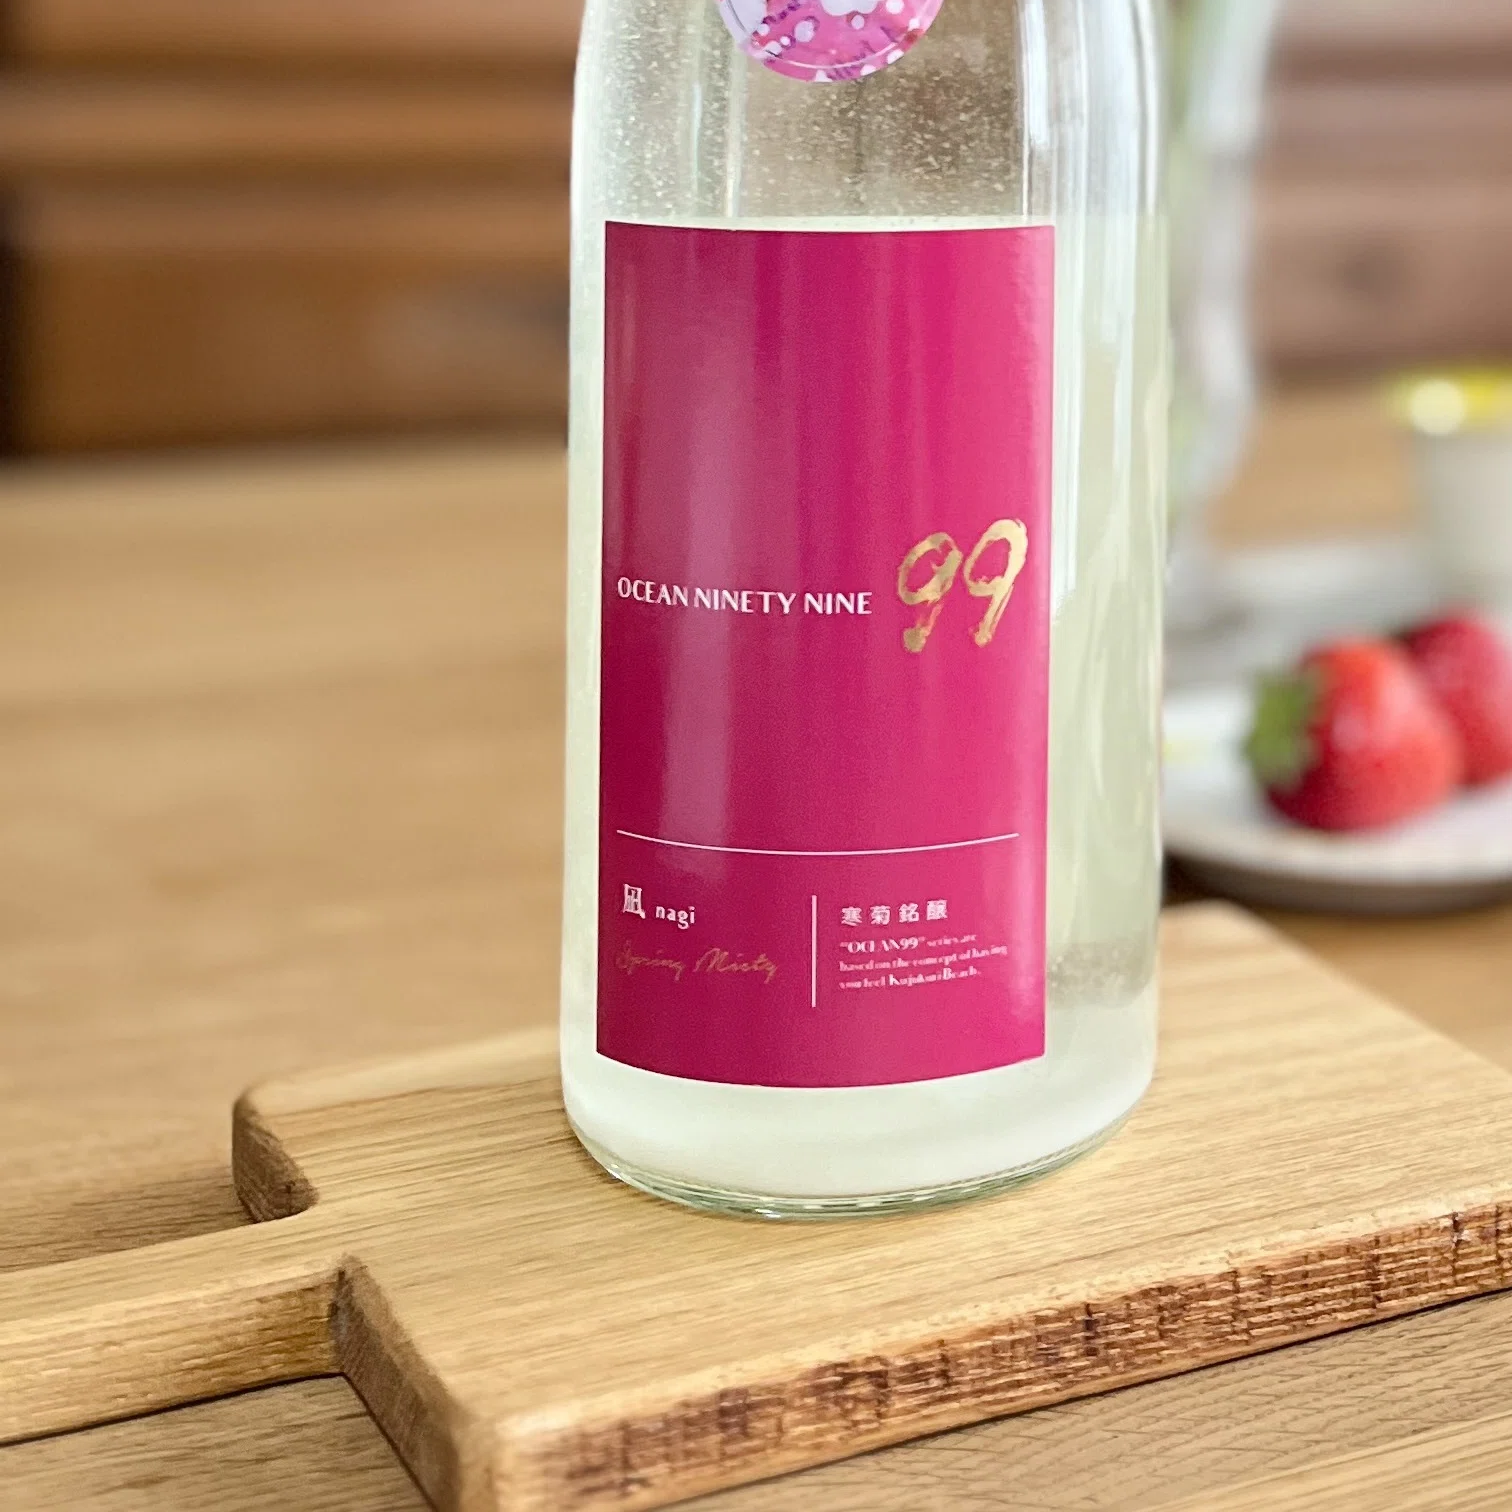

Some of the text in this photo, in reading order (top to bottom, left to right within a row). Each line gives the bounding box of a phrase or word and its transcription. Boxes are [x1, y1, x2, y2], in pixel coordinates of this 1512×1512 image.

[617, 518, 1028, 653] OCEAN NINETY NINE 99
[655, 906, 696, 930] nagi
